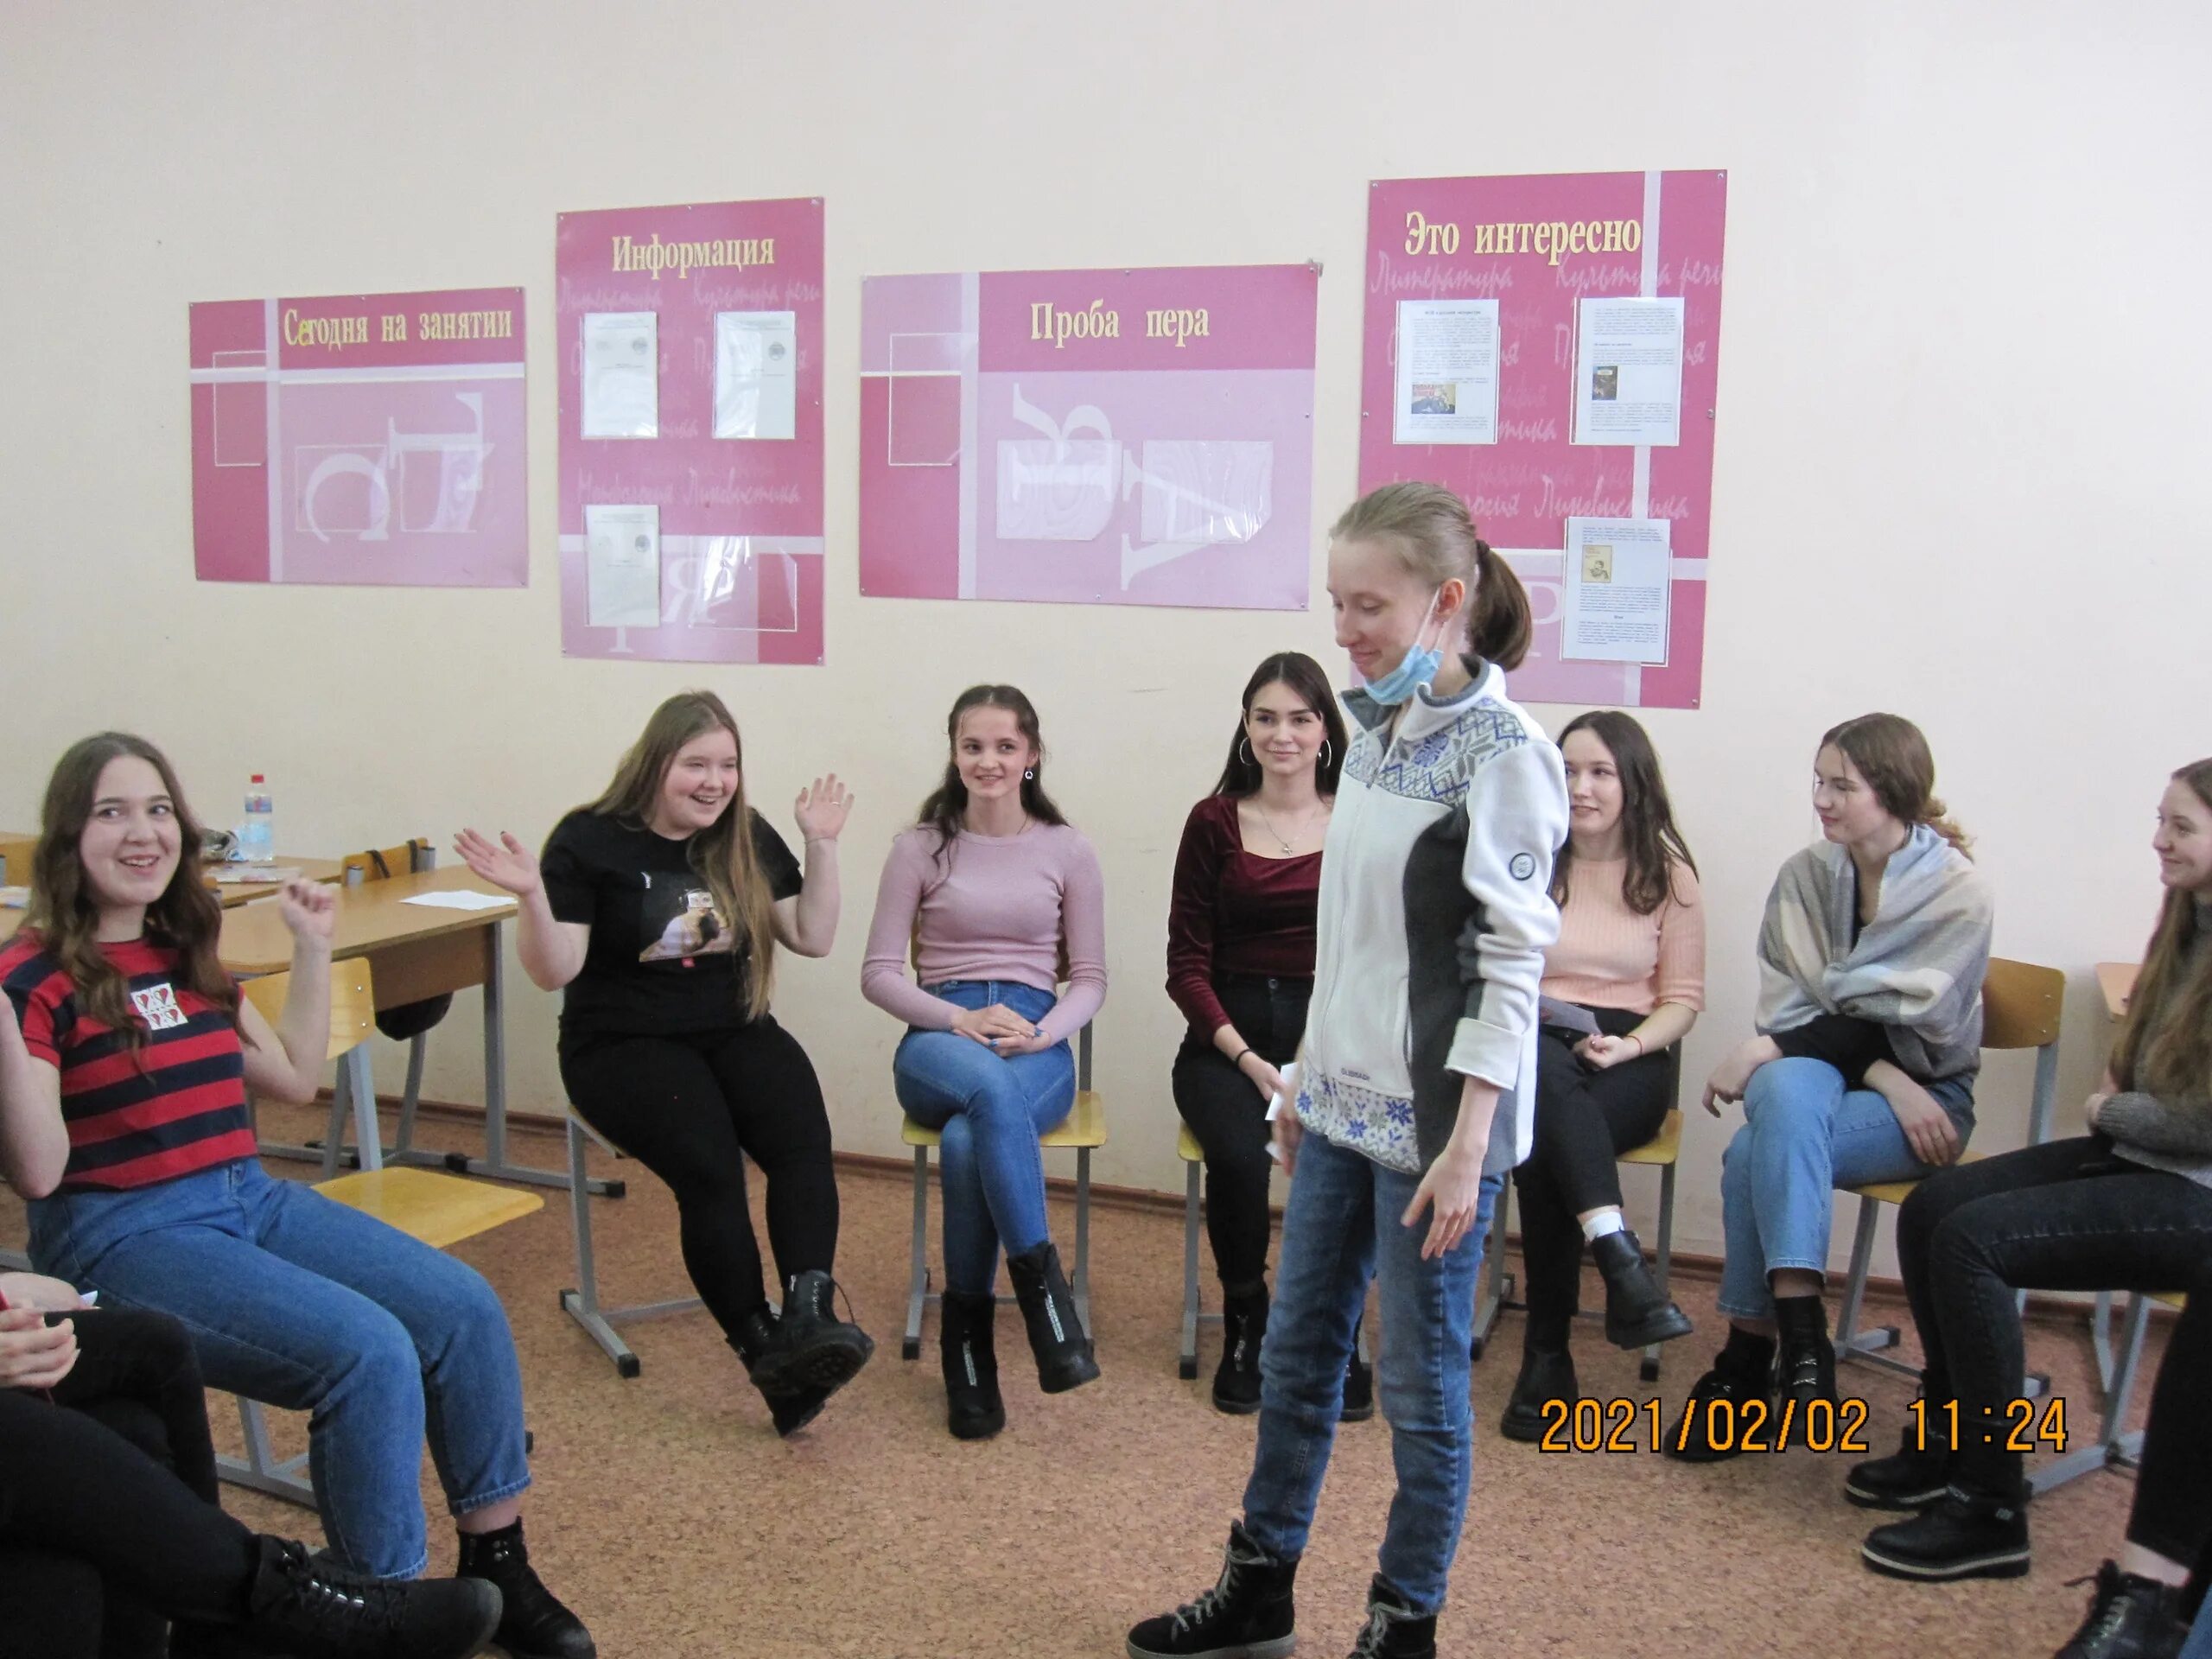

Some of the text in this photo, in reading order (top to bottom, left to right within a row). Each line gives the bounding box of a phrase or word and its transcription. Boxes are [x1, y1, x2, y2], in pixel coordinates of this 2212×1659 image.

[612, 233, 775, 280] Информация
[1404, 211, 1642, 266] Это интересно
[284, 308, 512, 352] Сегодня на занятии
[1031, 297, 1211, 349] Проба пера
